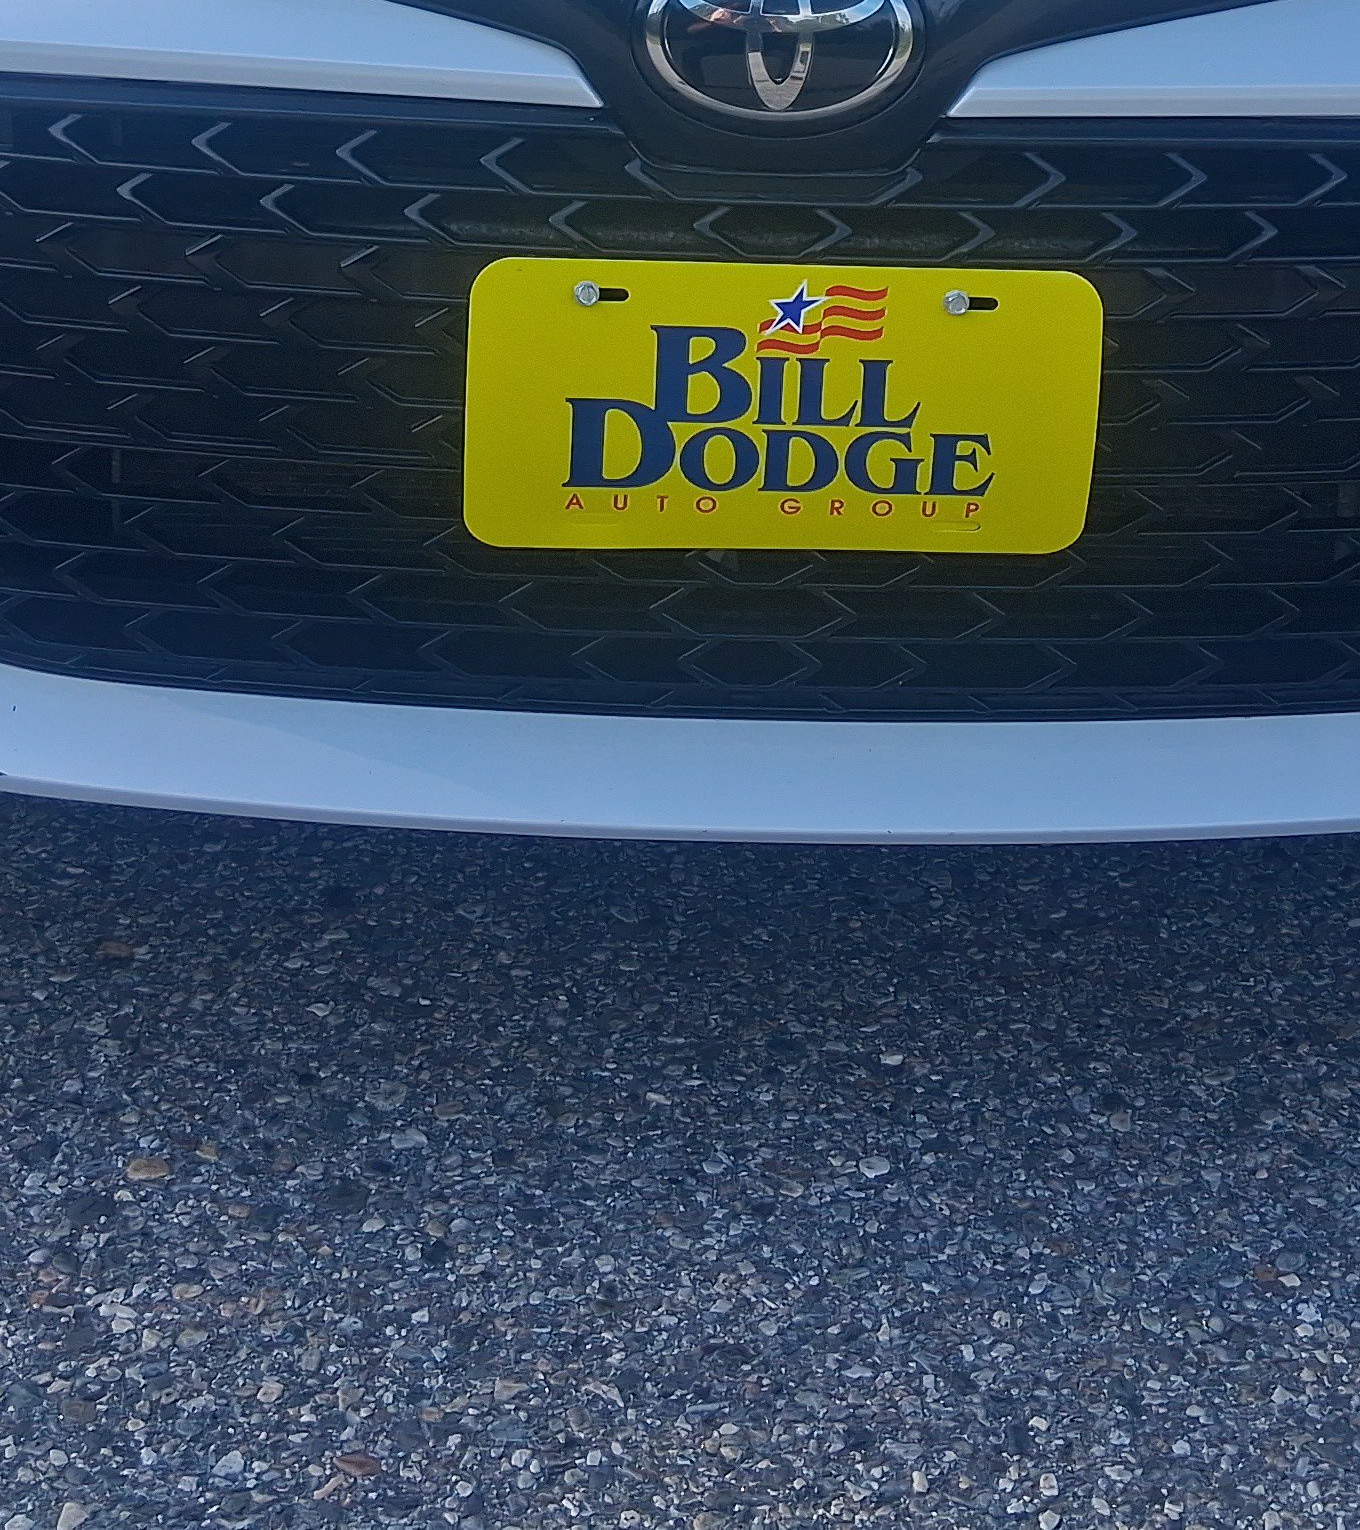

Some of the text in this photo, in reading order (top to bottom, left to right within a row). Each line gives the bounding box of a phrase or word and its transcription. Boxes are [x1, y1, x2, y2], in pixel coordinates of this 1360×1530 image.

[650, 324, 921, 428] BILL
[561, 397, 996, 497] DODGE
[564, 493, 981, 519] AUTO GROUP
